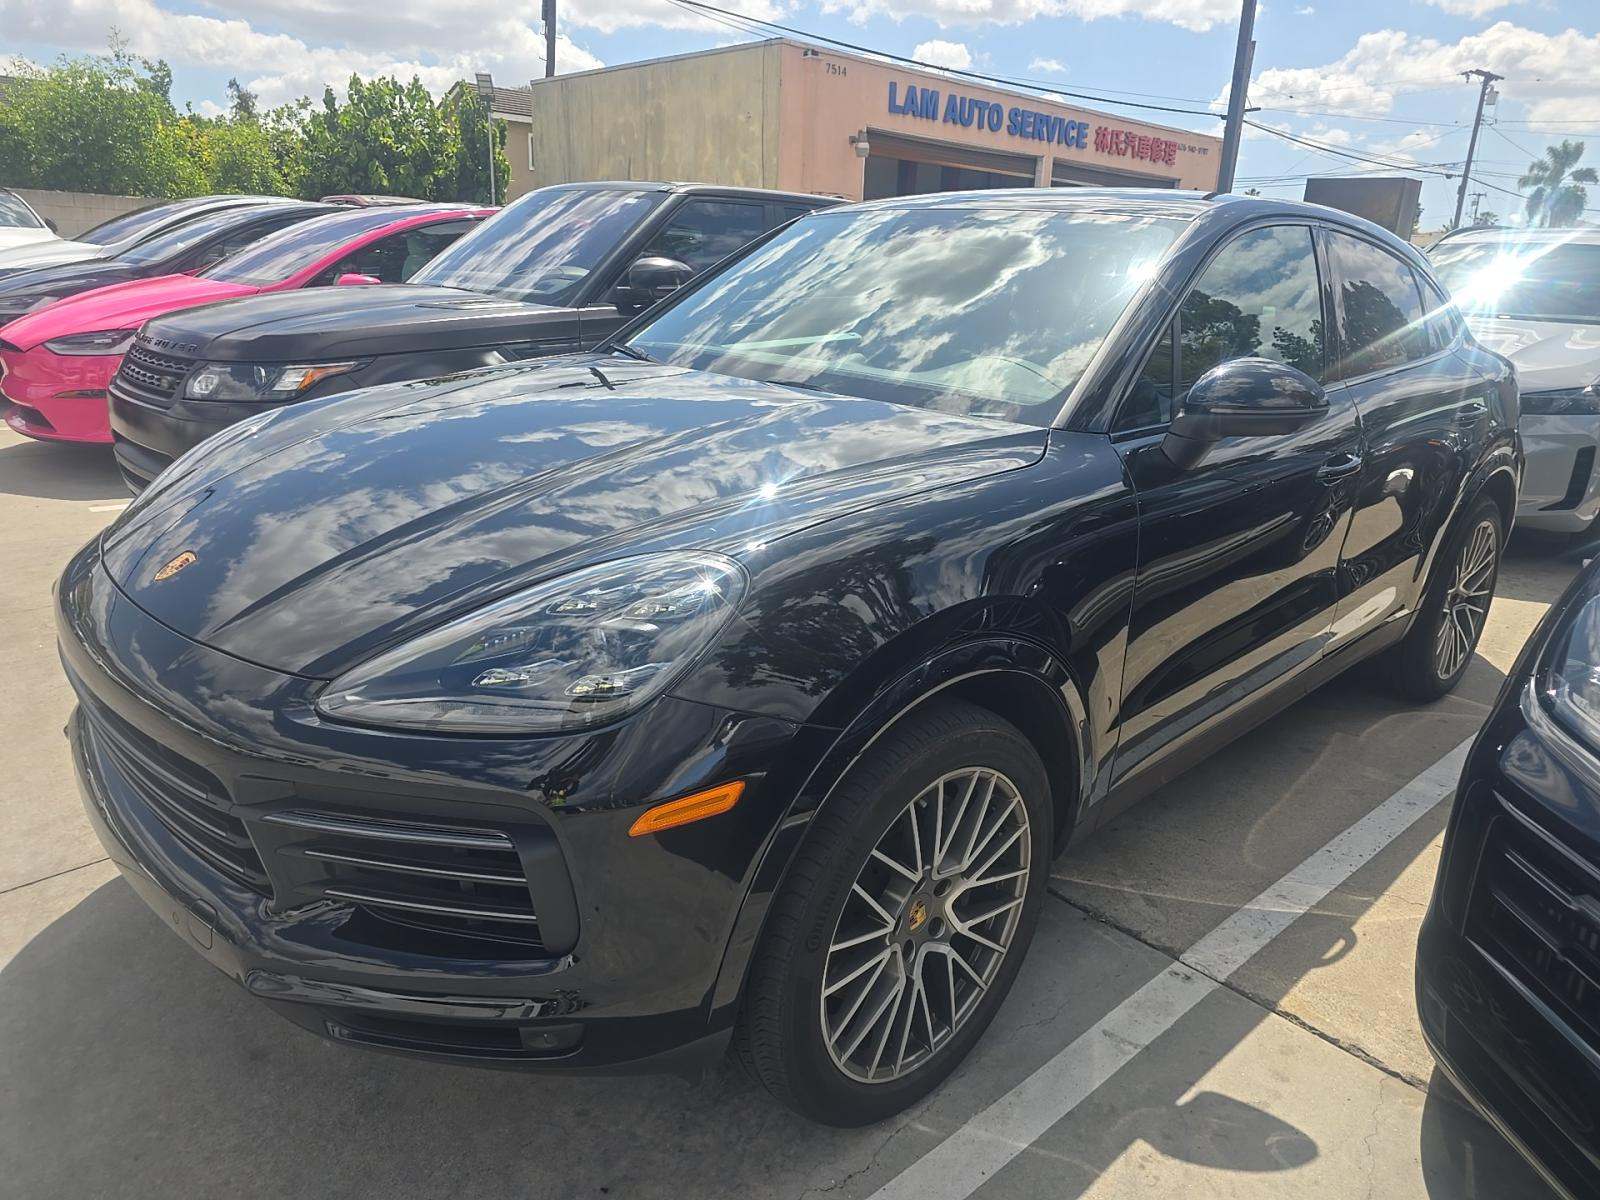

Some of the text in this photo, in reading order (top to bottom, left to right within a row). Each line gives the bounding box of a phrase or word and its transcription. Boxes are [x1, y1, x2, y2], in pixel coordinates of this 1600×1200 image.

[826, 63, 847, 77] 7514
[888, 81, 1089, 149] LAM AUTO SERVICE
